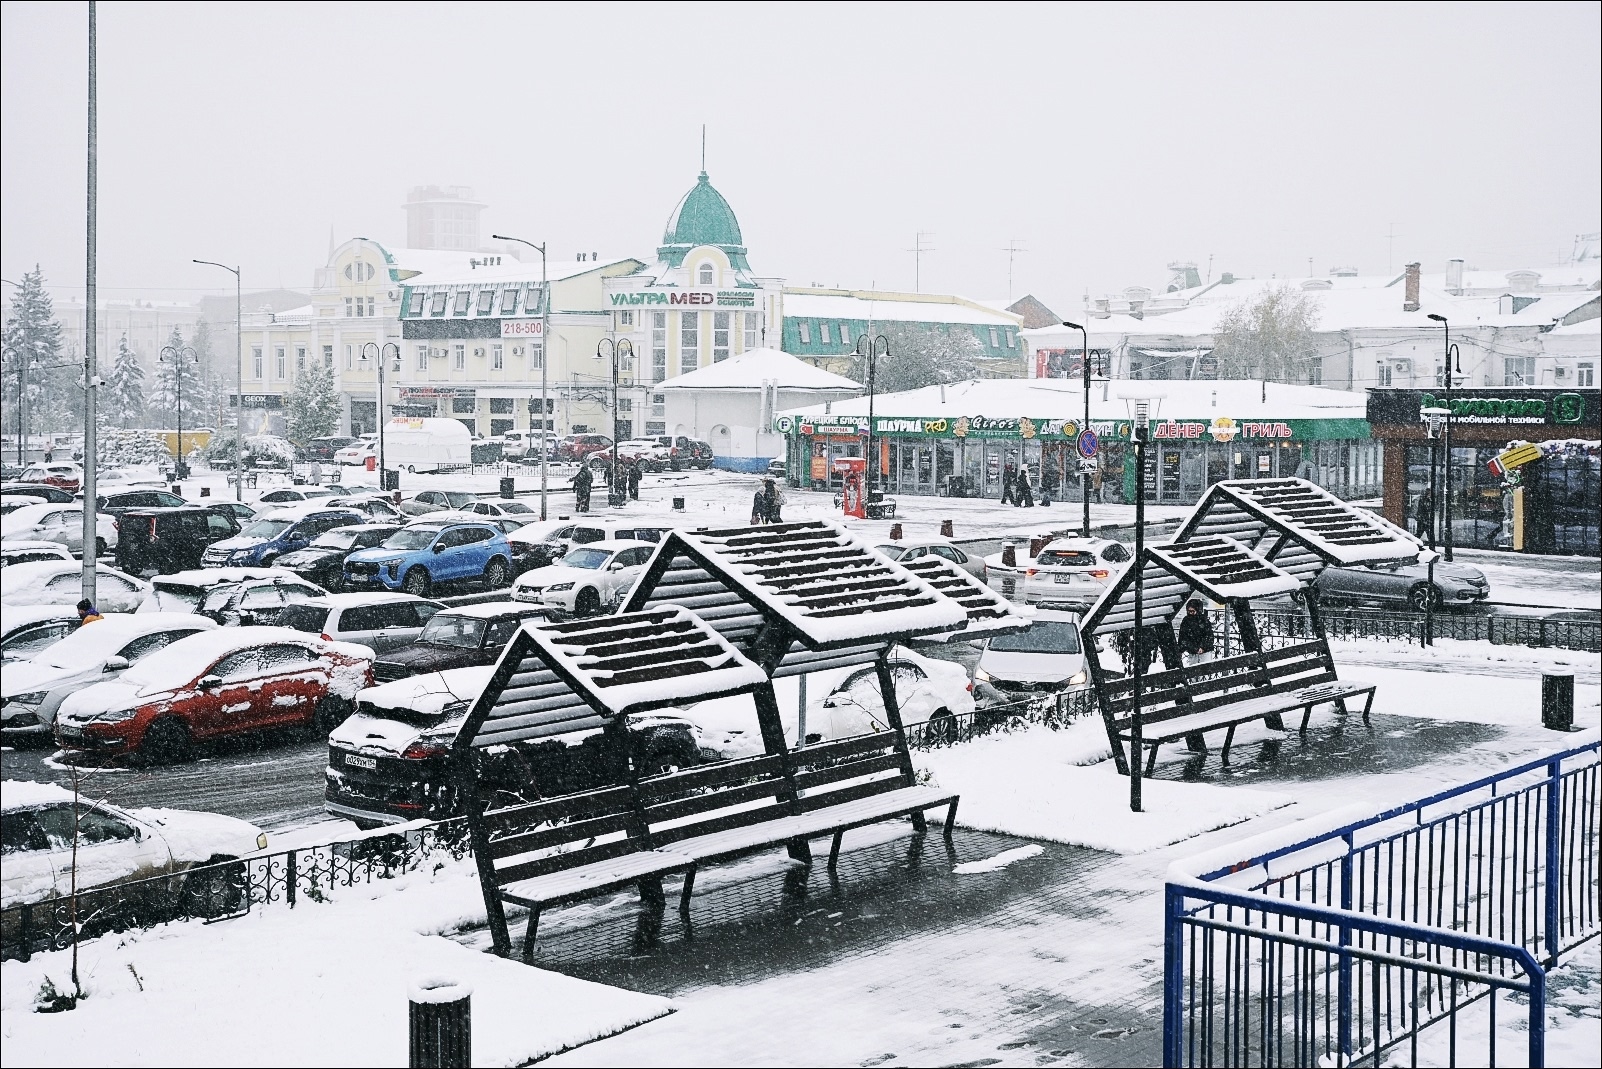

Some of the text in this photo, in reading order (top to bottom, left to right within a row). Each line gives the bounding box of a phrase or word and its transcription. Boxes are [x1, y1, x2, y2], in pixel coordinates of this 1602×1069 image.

[504, 323, 542, 334] 218-500
[801, 416, 869, 425] ТУРЕЦКИЕ БЛЮДА
[924, 418, 948, 433] PRO
[1457, 415, 1506, 424] мобильной
[876, 420, 922, 433] ШАУРМА
[1155, 421, 1205, 438] ДЁНЕР
[1242, 422, 1293, 438] ГРИЛЬ
